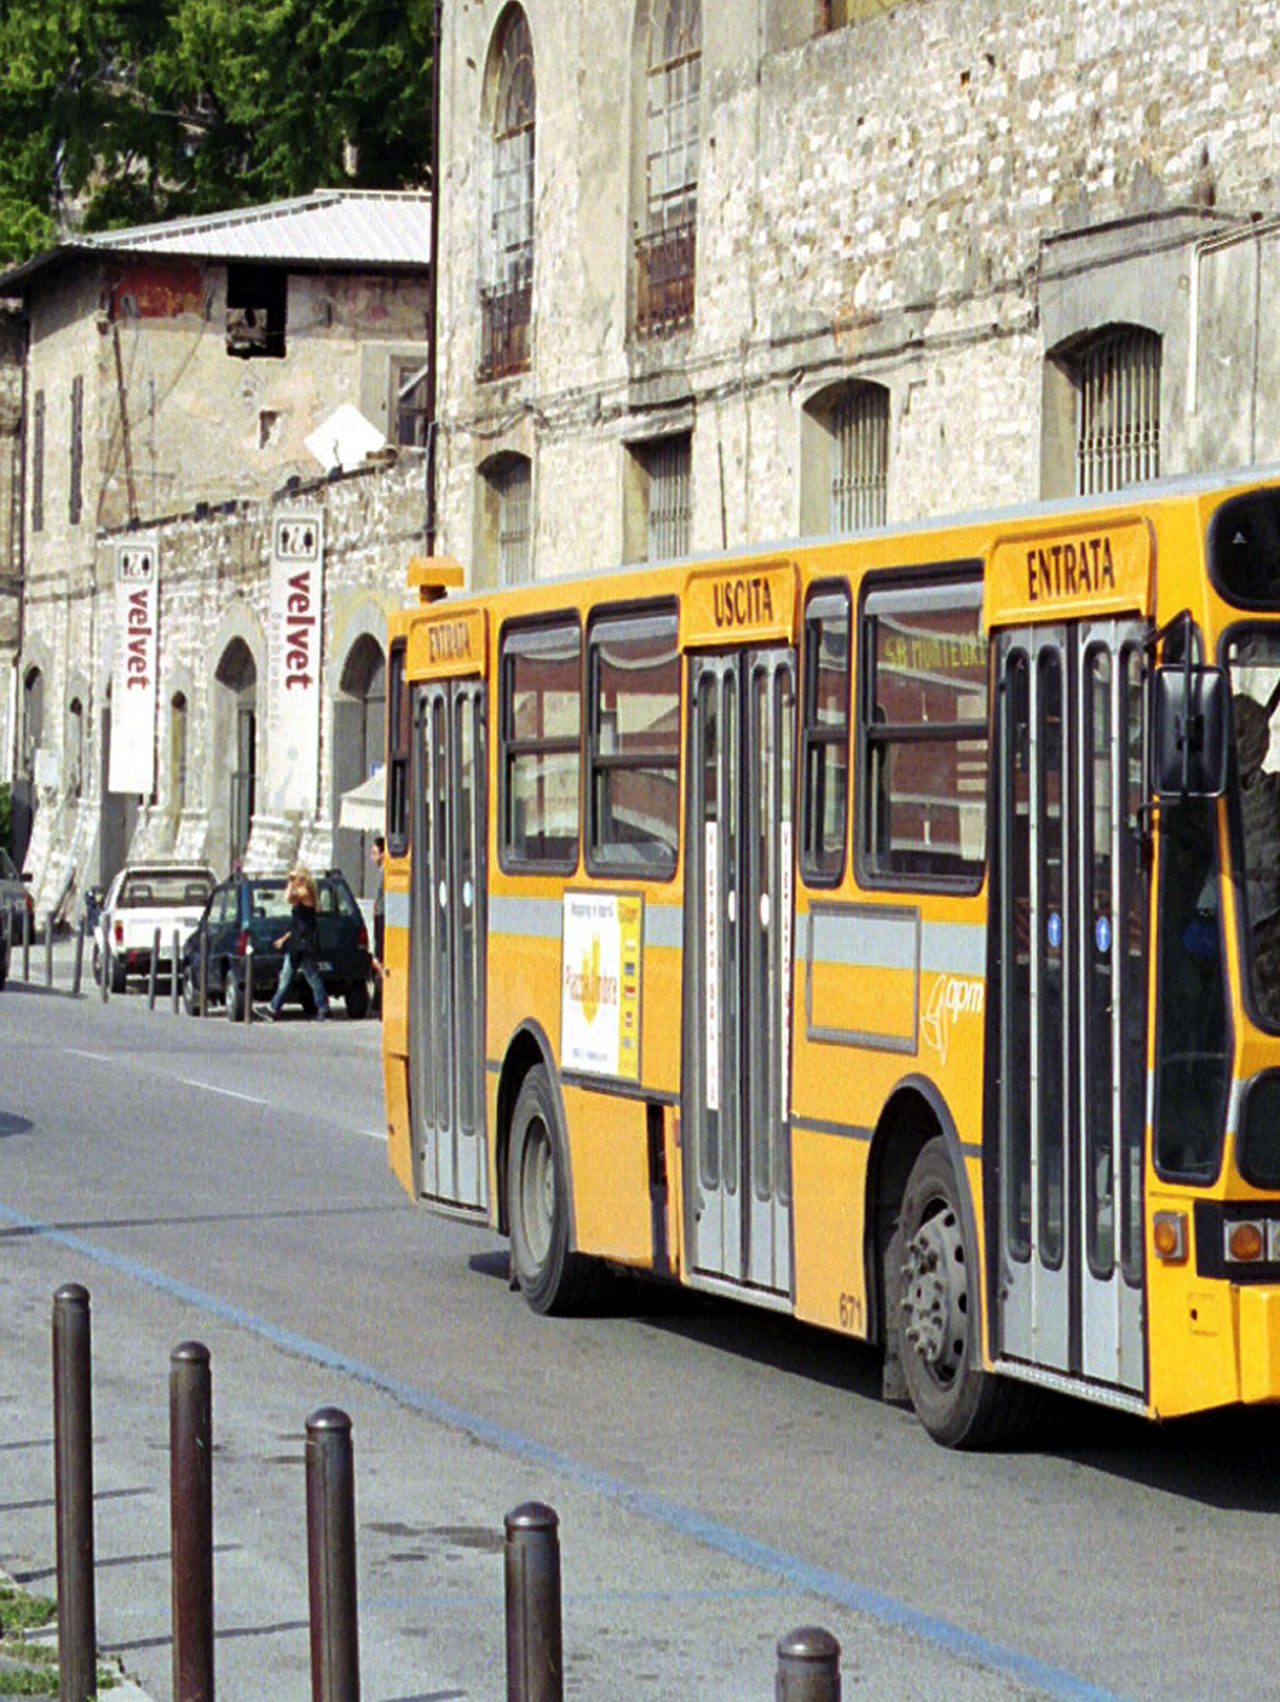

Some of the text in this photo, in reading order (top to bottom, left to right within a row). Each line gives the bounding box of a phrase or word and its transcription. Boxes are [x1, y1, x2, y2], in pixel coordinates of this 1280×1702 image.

[1027, 536, 1115, 601] ENTRATA
[285, 570, 316, 691] velvet
[713, 576, 774, 628] USCITA
[127, 589, 152, 690] velvet
[840, 1292, 863, 1330] 671
